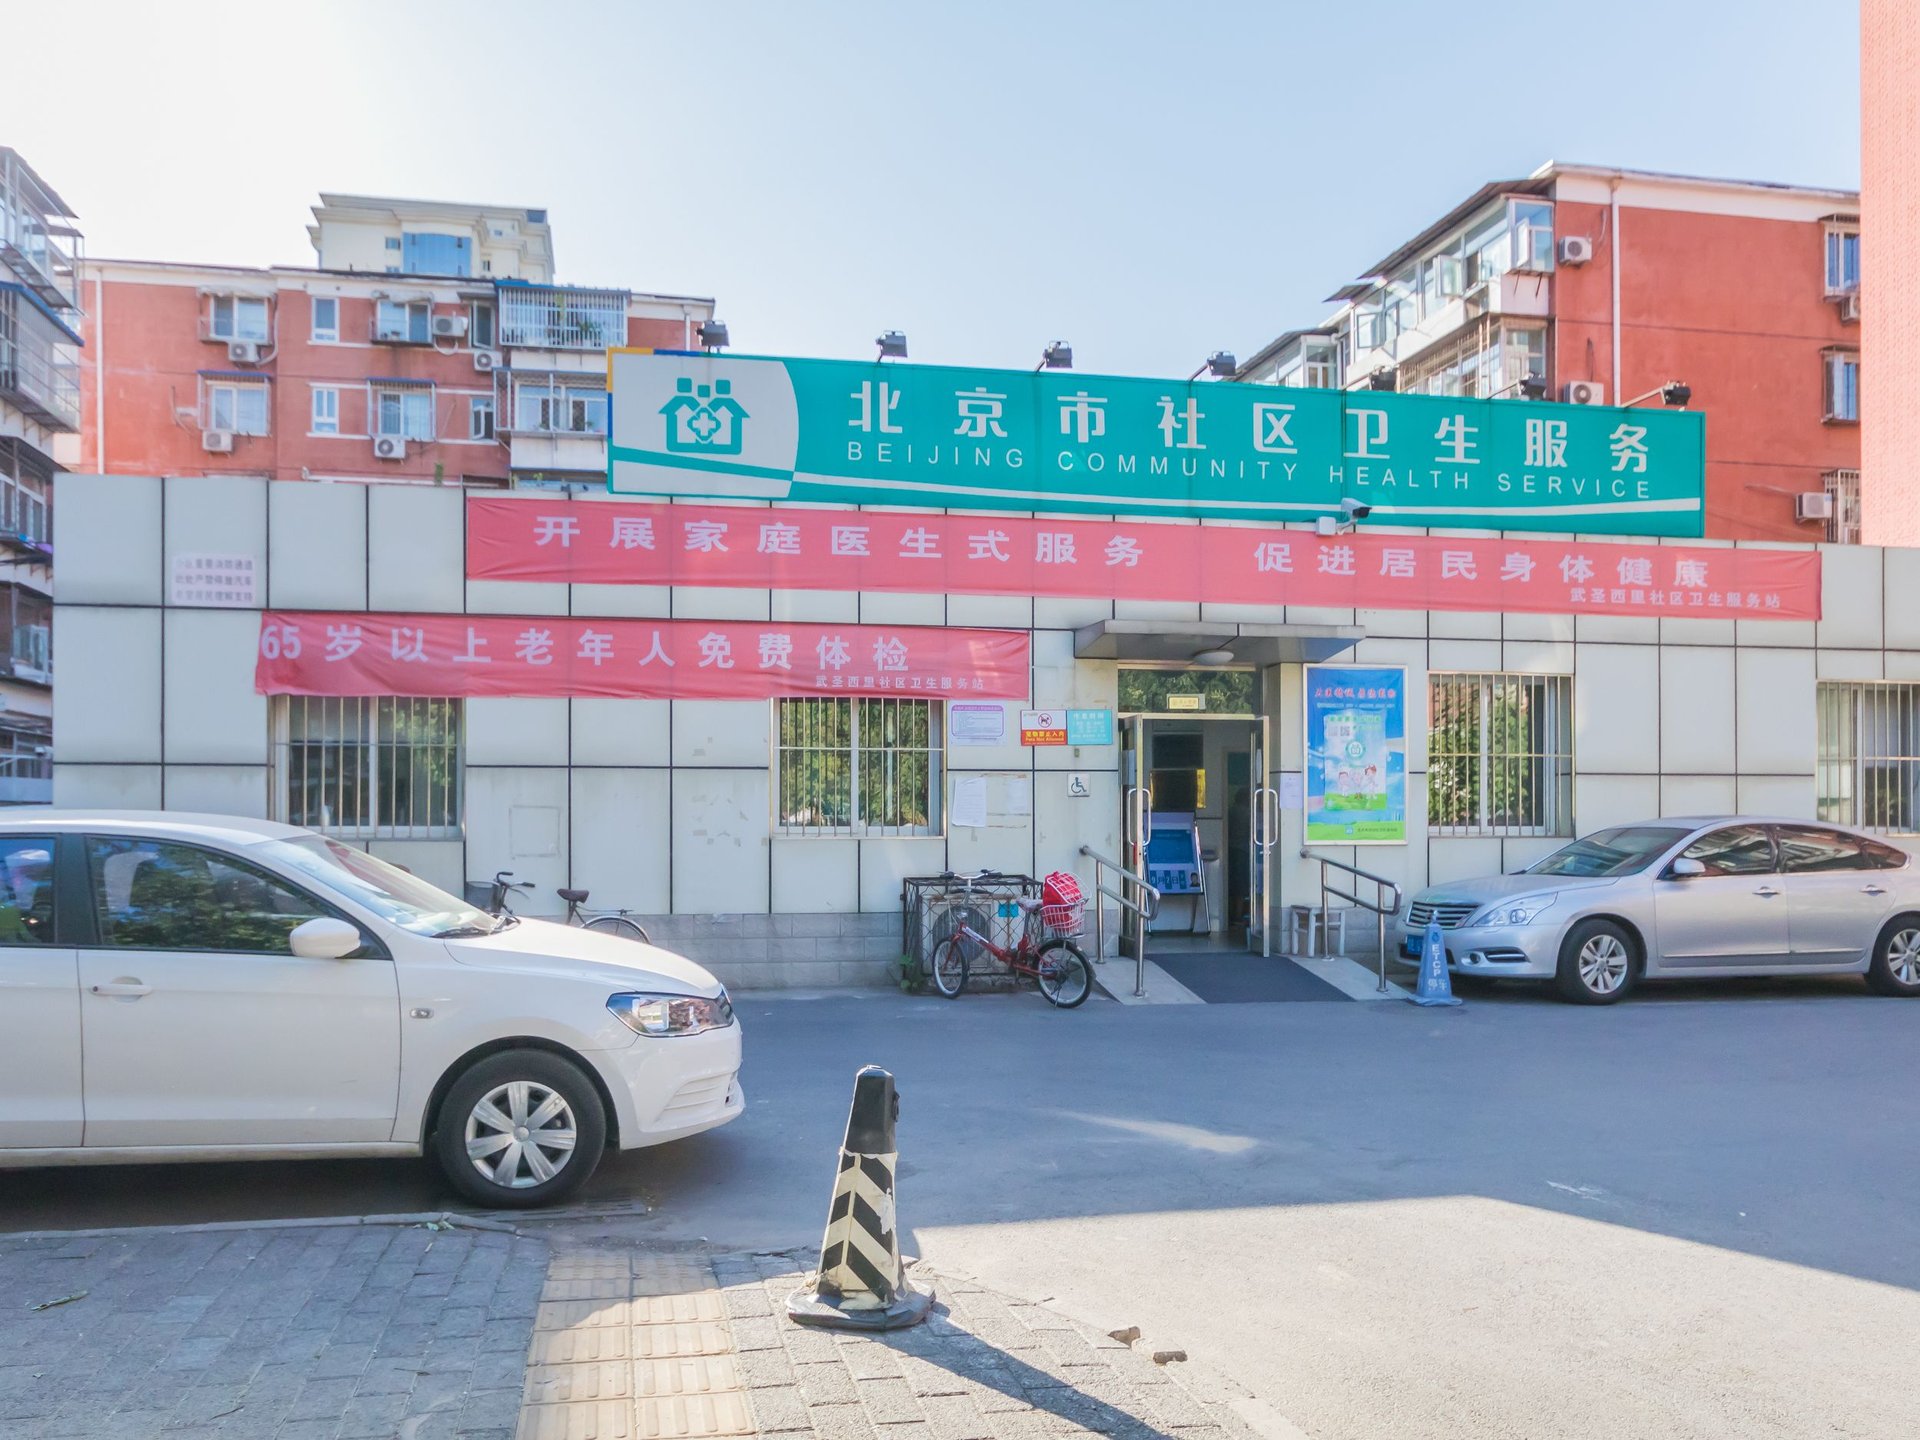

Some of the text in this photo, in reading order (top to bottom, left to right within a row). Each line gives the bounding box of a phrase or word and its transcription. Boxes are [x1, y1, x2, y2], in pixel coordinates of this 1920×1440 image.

[849, 380, 1648, 473] 北京市社区卫生服务
[848, 442, 1650, 499] BEIJING COMMUNITY HEALTH SERVICE
[533, 515, 1709, 588] 开展家庭医生式服务 促进居民身体健康
[1570, 587, 1781, 609] 武圣西里社区卫生服务站
[260, 625, 909, 672] 65岁以上老年人免费体检
[815, 674, 985, 691] 武圣西里社区卫生服务站
[1432, 943, 1442, 977] ETCP
